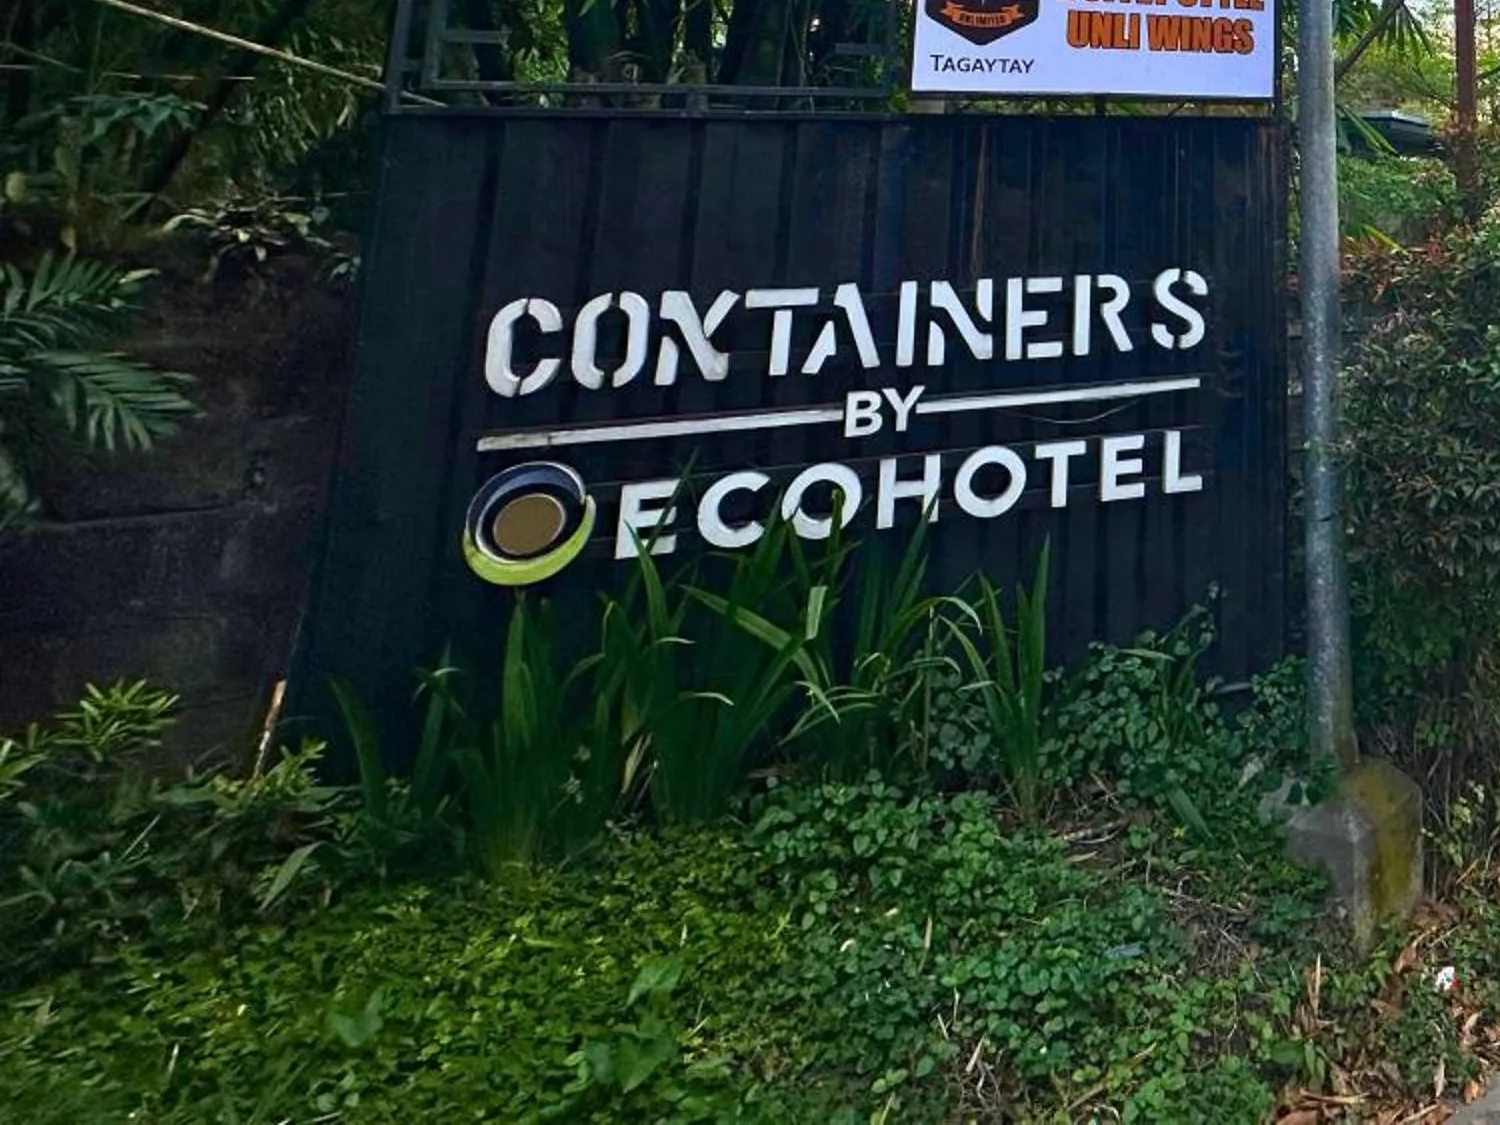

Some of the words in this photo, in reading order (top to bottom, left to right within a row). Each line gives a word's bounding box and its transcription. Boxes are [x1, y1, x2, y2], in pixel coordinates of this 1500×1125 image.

[1066, 9, 1141, 50] UNLI
[1146, 14, 1256, 55] WINGS
[929, 54, 1036, 74] TAGAYTAY
[485, 268, 1208, 397] CONTAINERS
[843, 385, 926, 438] BY
[614, 430, 1203, 561] ECOHOTEL
